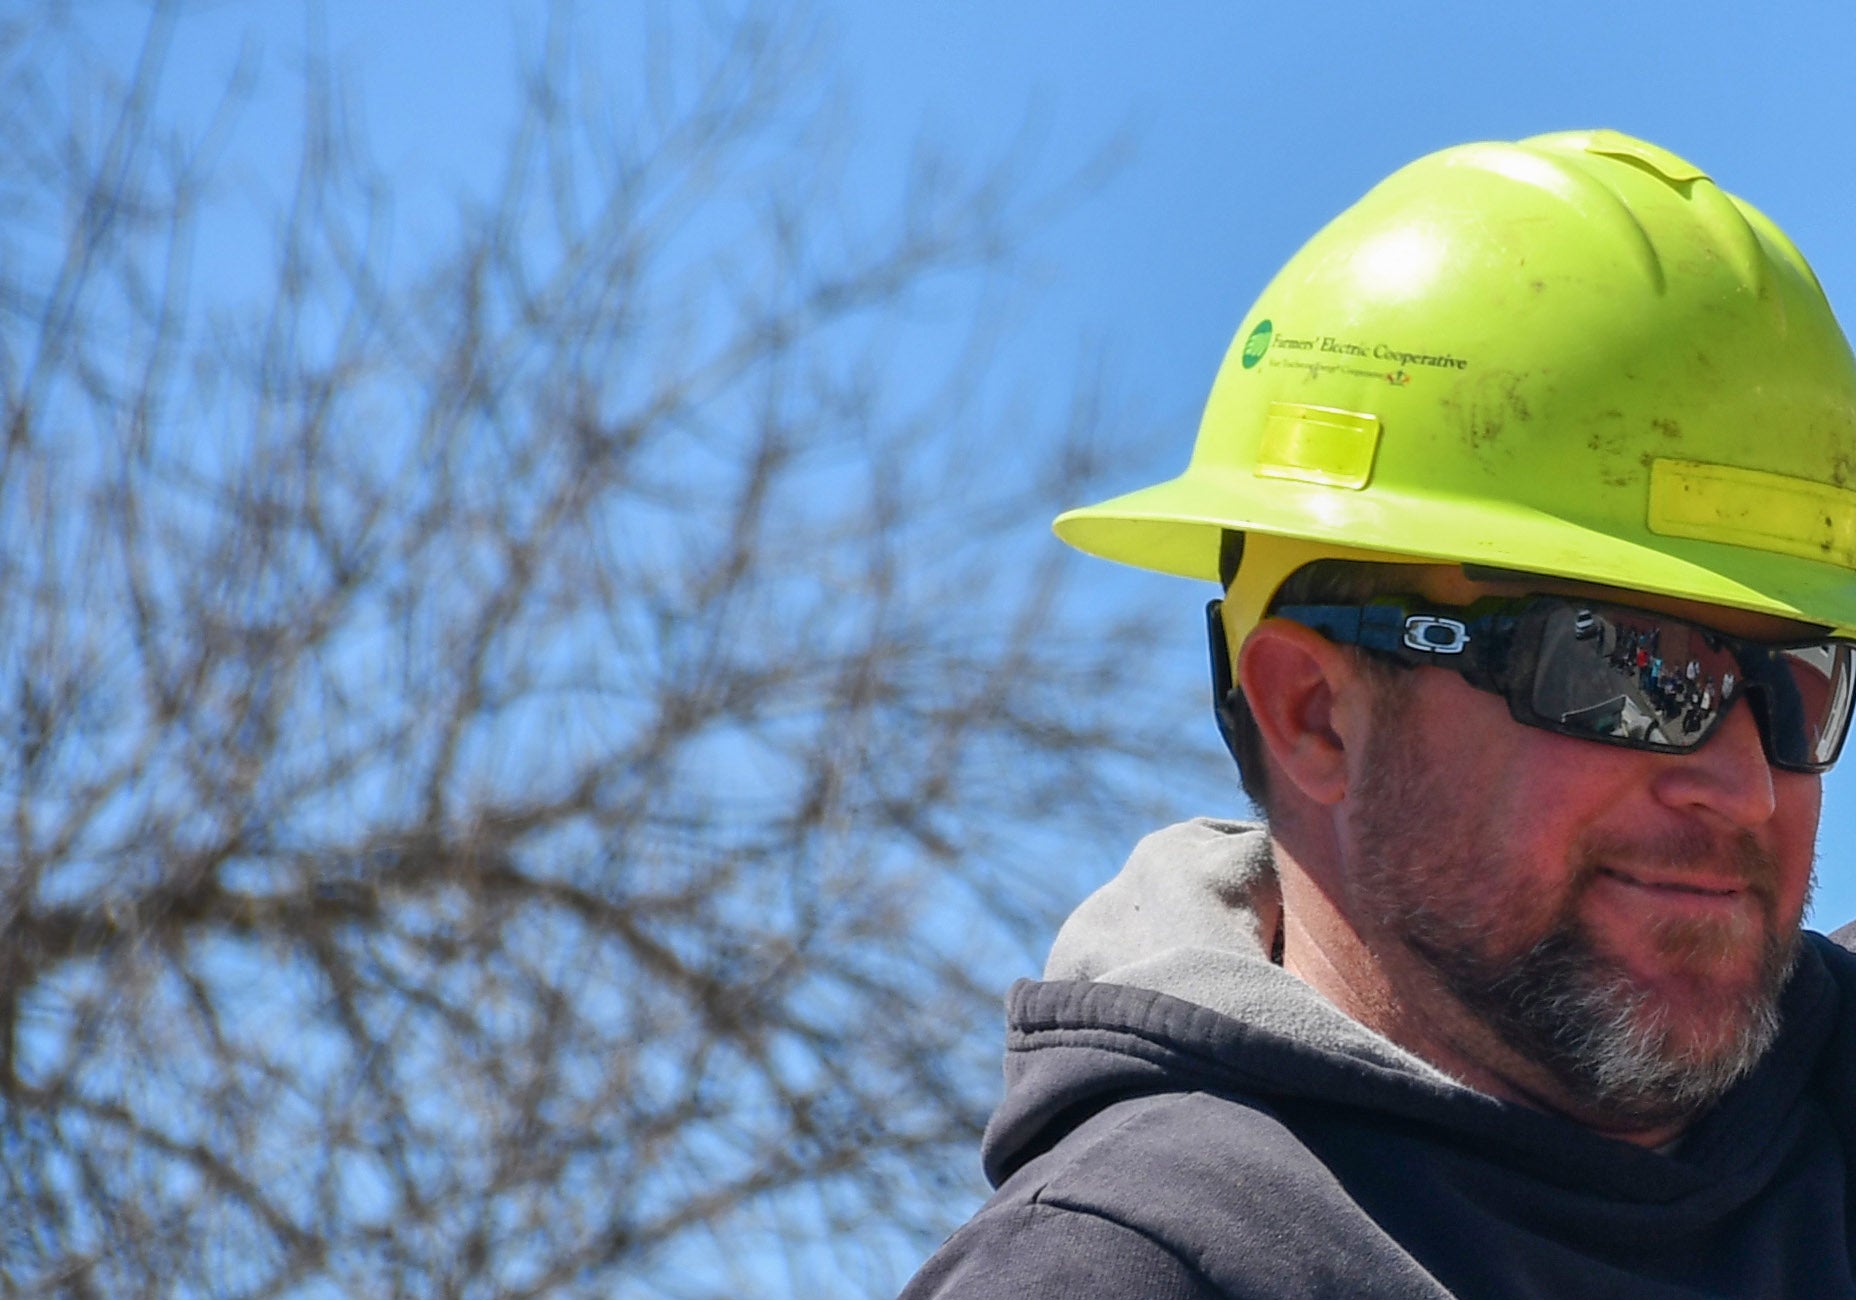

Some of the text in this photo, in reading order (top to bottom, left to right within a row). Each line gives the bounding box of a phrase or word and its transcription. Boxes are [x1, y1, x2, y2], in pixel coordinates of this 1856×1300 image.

[1272, 333, 1320, 351] Farmers'
[1320, 337, 1370, 358] Electric
[1373, 343, 1468, 370] Cooperative
